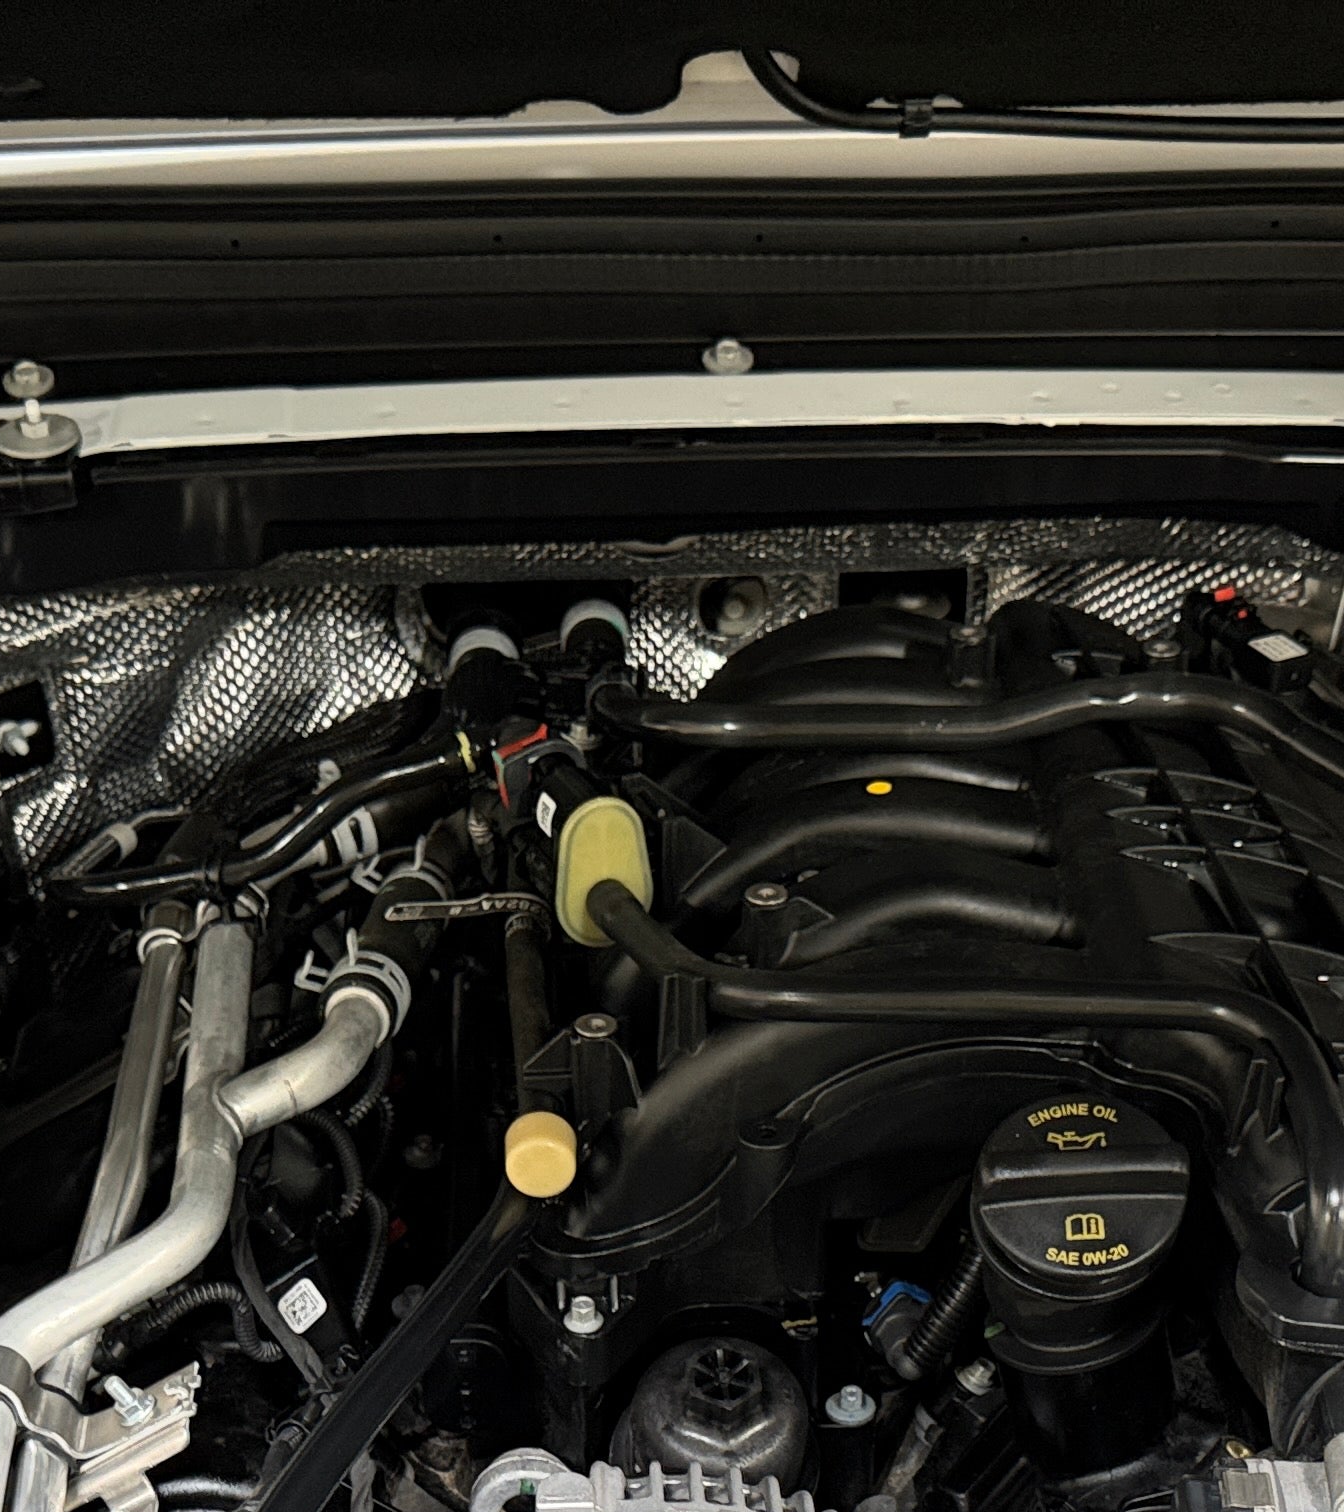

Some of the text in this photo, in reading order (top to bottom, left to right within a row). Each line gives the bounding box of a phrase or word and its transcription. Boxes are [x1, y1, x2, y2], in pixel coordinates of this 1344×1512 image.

[1027, 1103, 1119, 1128] ENGINE OIL
[1045, 1243, 1130, 1266] SAE 0W-20
